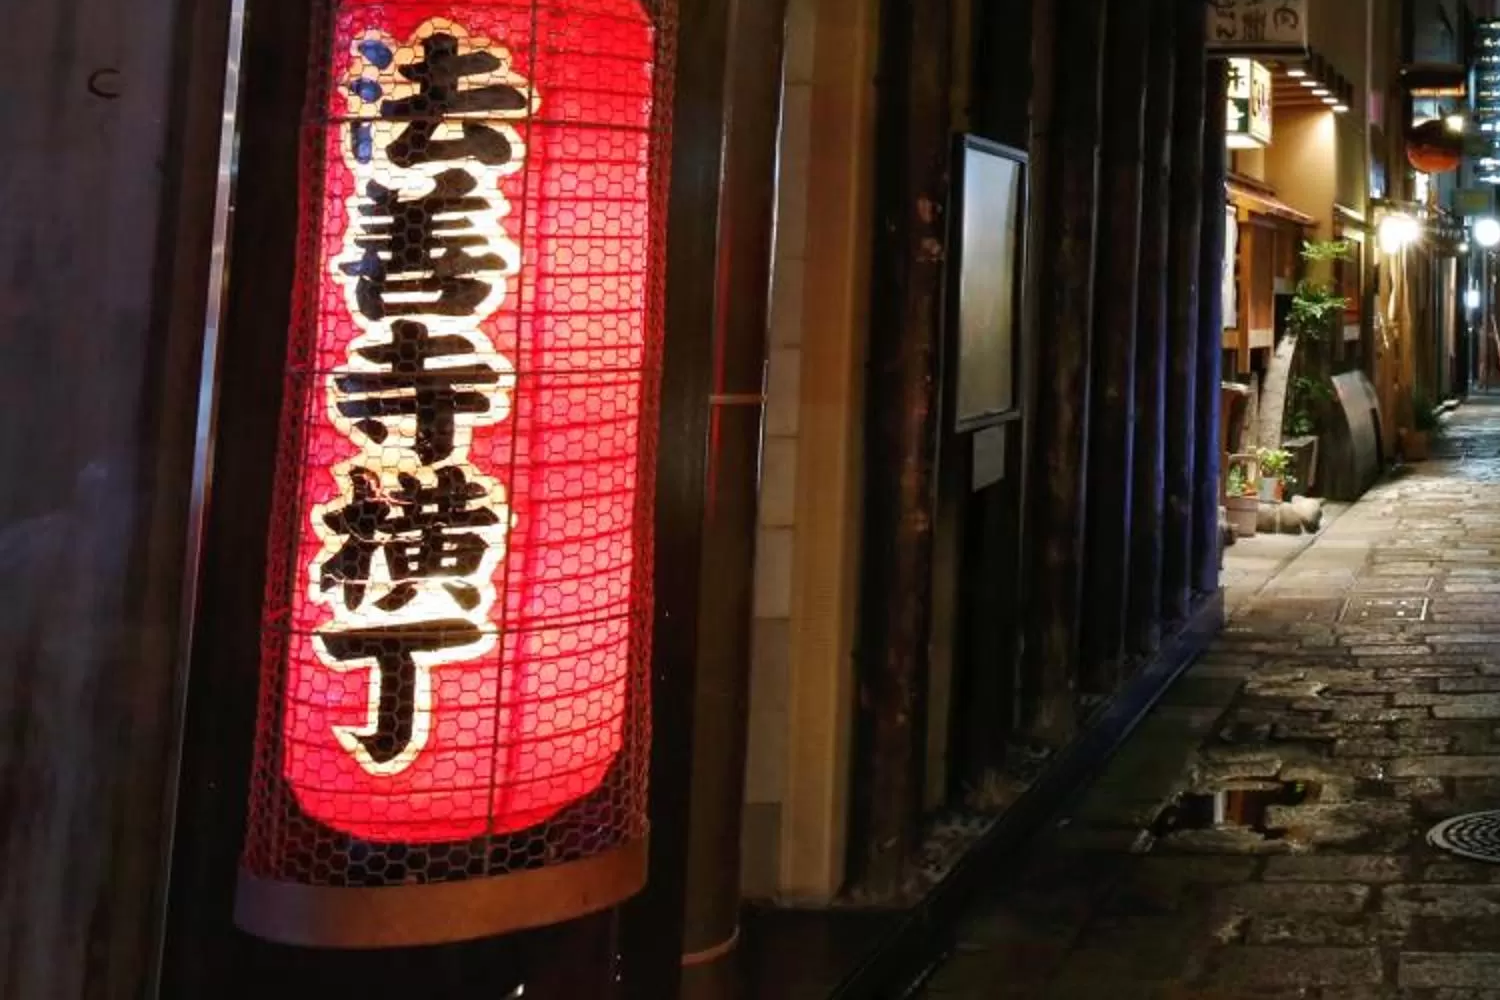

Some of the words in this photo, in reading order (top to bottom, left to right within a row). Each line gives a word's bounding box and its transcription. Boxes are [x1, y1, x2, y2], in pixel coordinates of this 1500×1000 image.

[317, 30, 530, 766] 法善寺横丁
